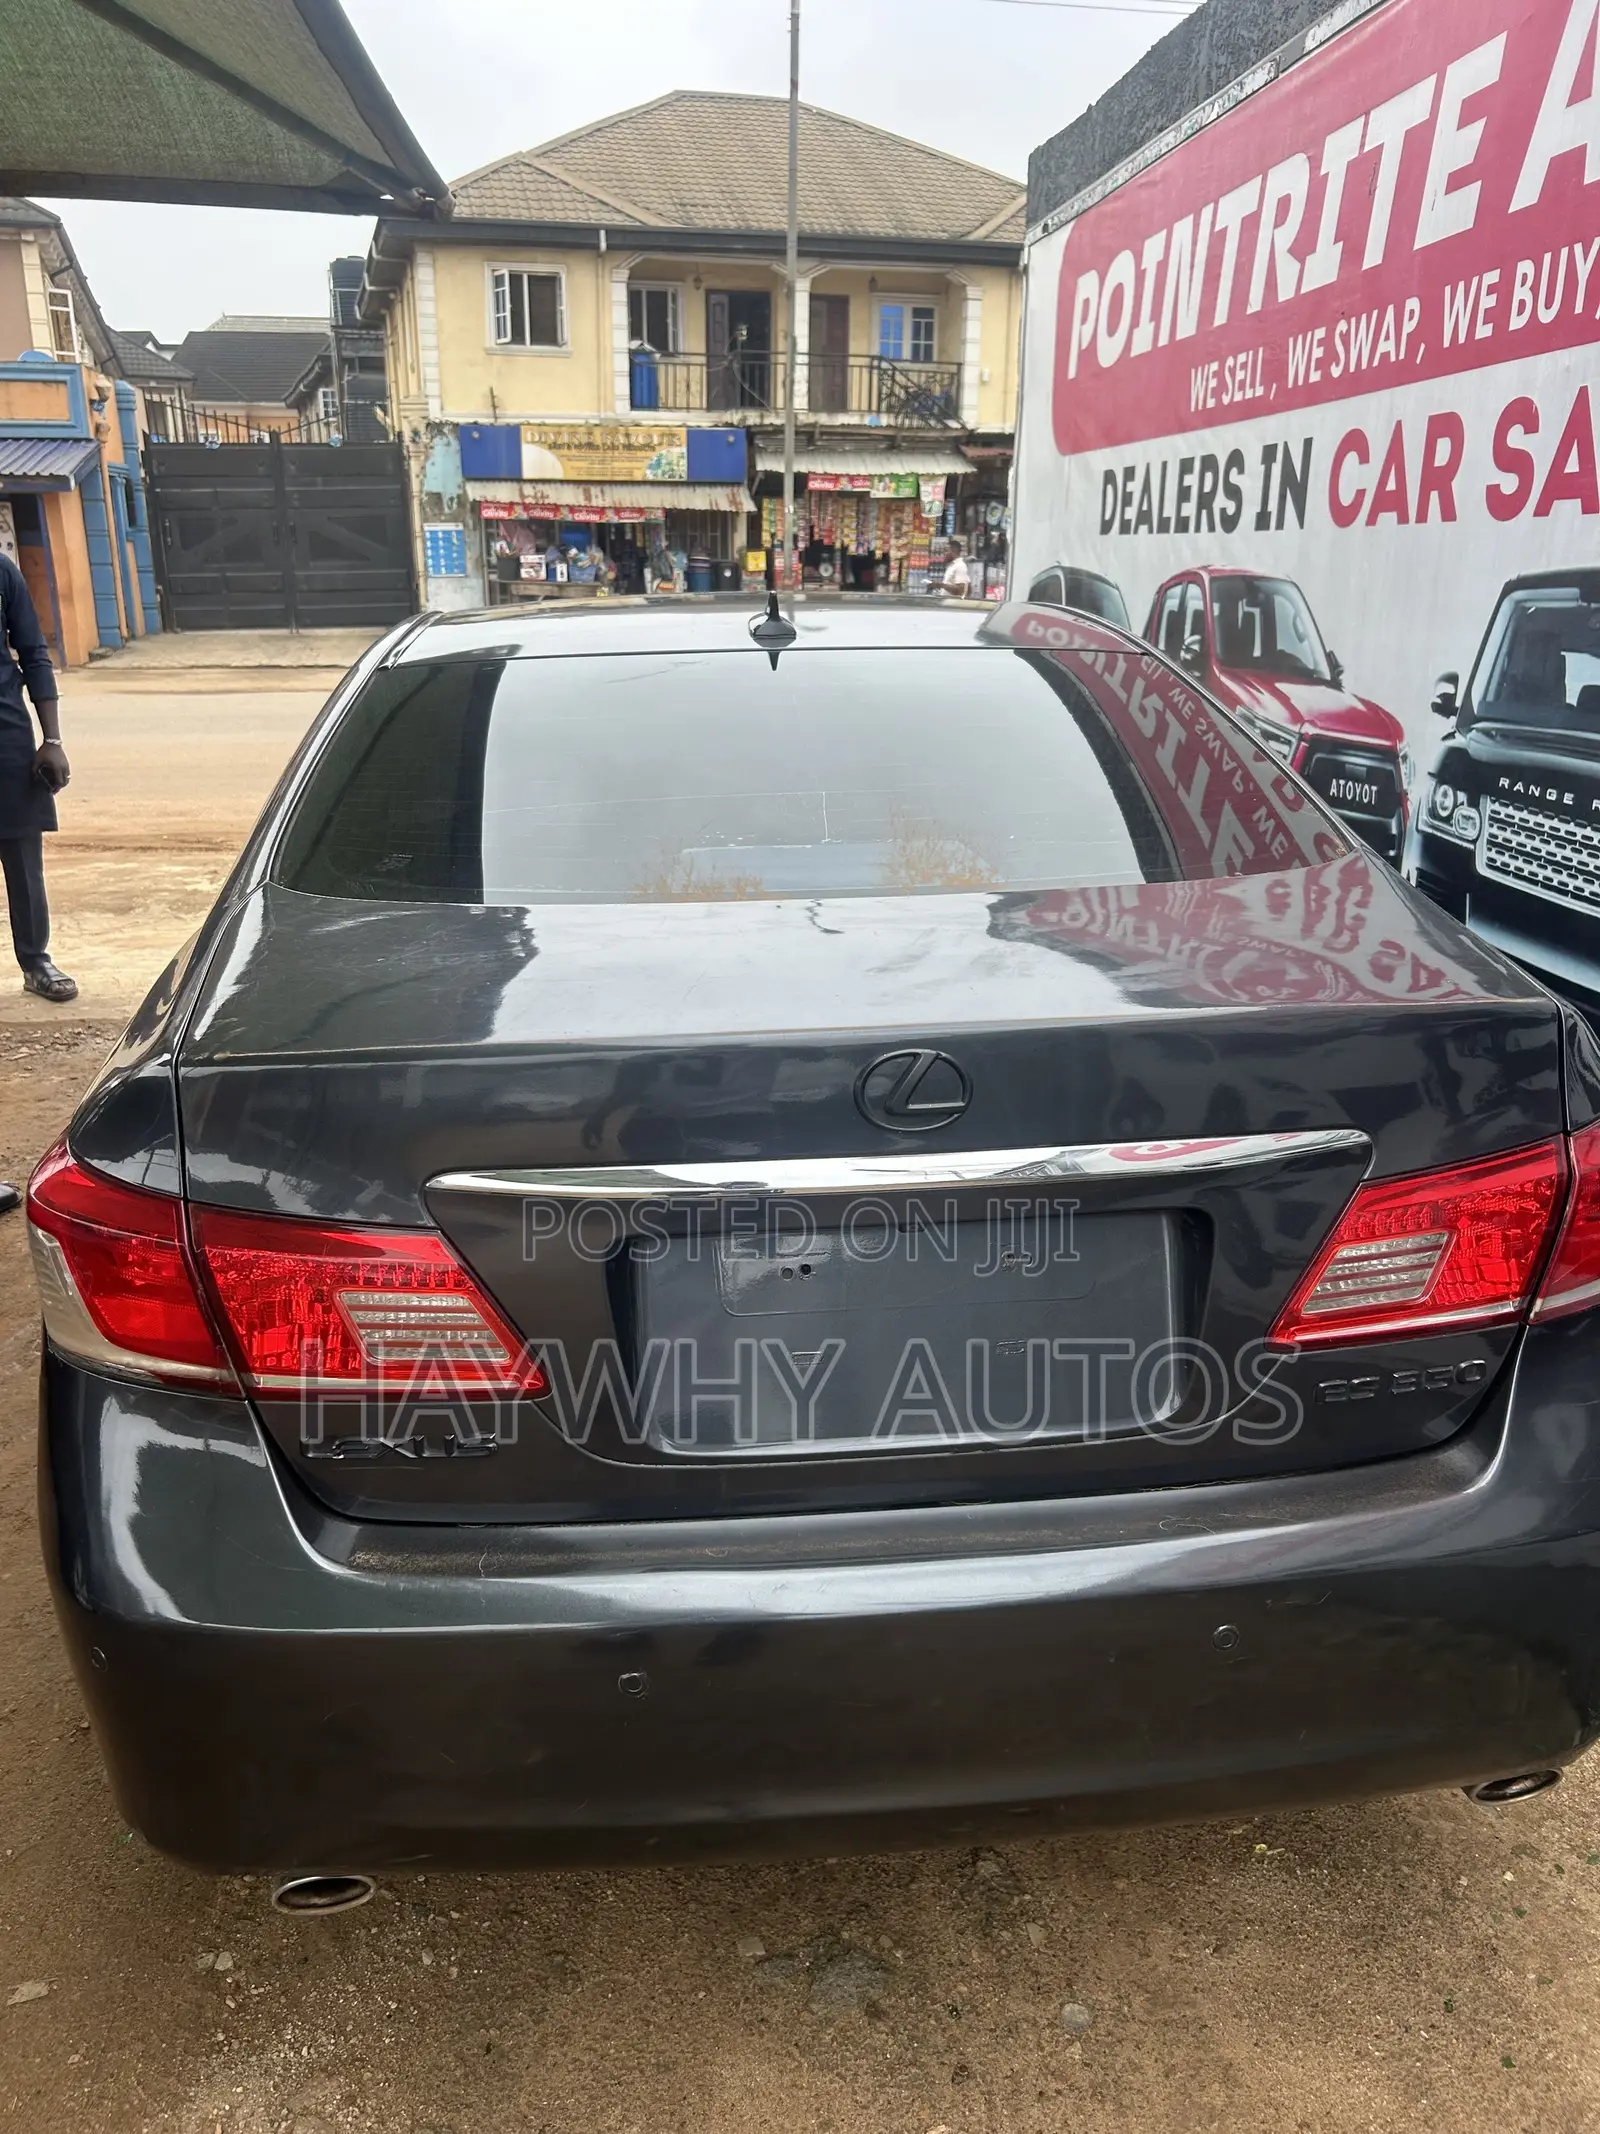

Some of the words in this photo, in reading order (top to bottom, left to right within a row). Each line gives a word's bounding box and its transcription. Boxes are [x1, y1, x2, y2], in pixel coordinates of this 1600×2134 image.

[1067, 30, 1508, 380] POINTRITE
[1190, 365, 1217, 413] WE
[1287, 328, 1325, 389] WE
[1330, 295, 1427, 379] SWAP,
[1442, 268, 1501, 349] WE
[1099, 447, 1246, 537] DEALERS
[1254, 436, 1314, 533] IN
[1327, 410, 1467, 530] CAR
[1329, 778, 1378, 806] ATOYOT
[1498, 776, 1575, 806] RANGE
[1312, 1375, 1381, 1405] ES
[300, 1432, 499, 1459] LEXUS
